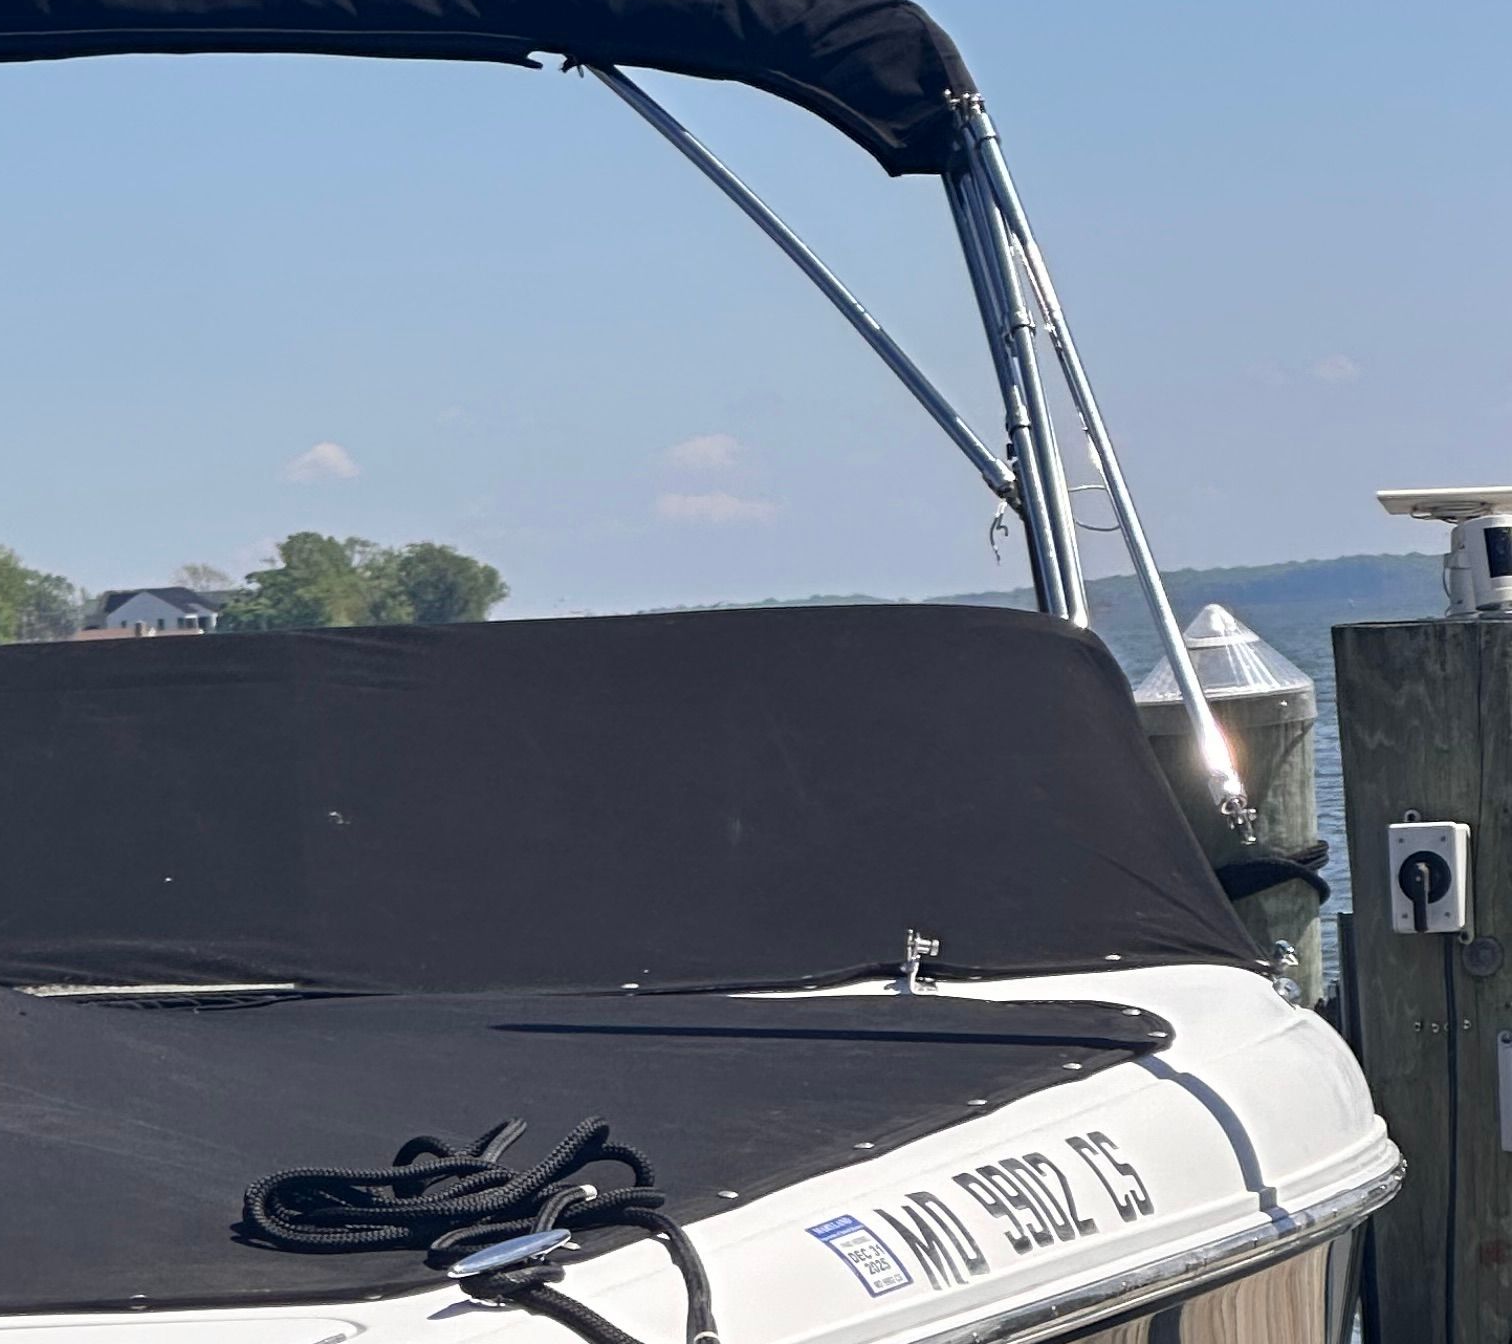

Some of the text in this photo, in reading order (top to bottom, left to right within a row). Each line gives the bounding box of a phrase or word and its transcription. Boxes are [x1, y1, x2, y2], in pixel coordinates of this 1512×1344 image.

[872, 1131, 1155, 1291] MD 9902 CS
[847, 1244, 886, 1264] DEC 31
[863, 1257, 892, 1275] 2025
